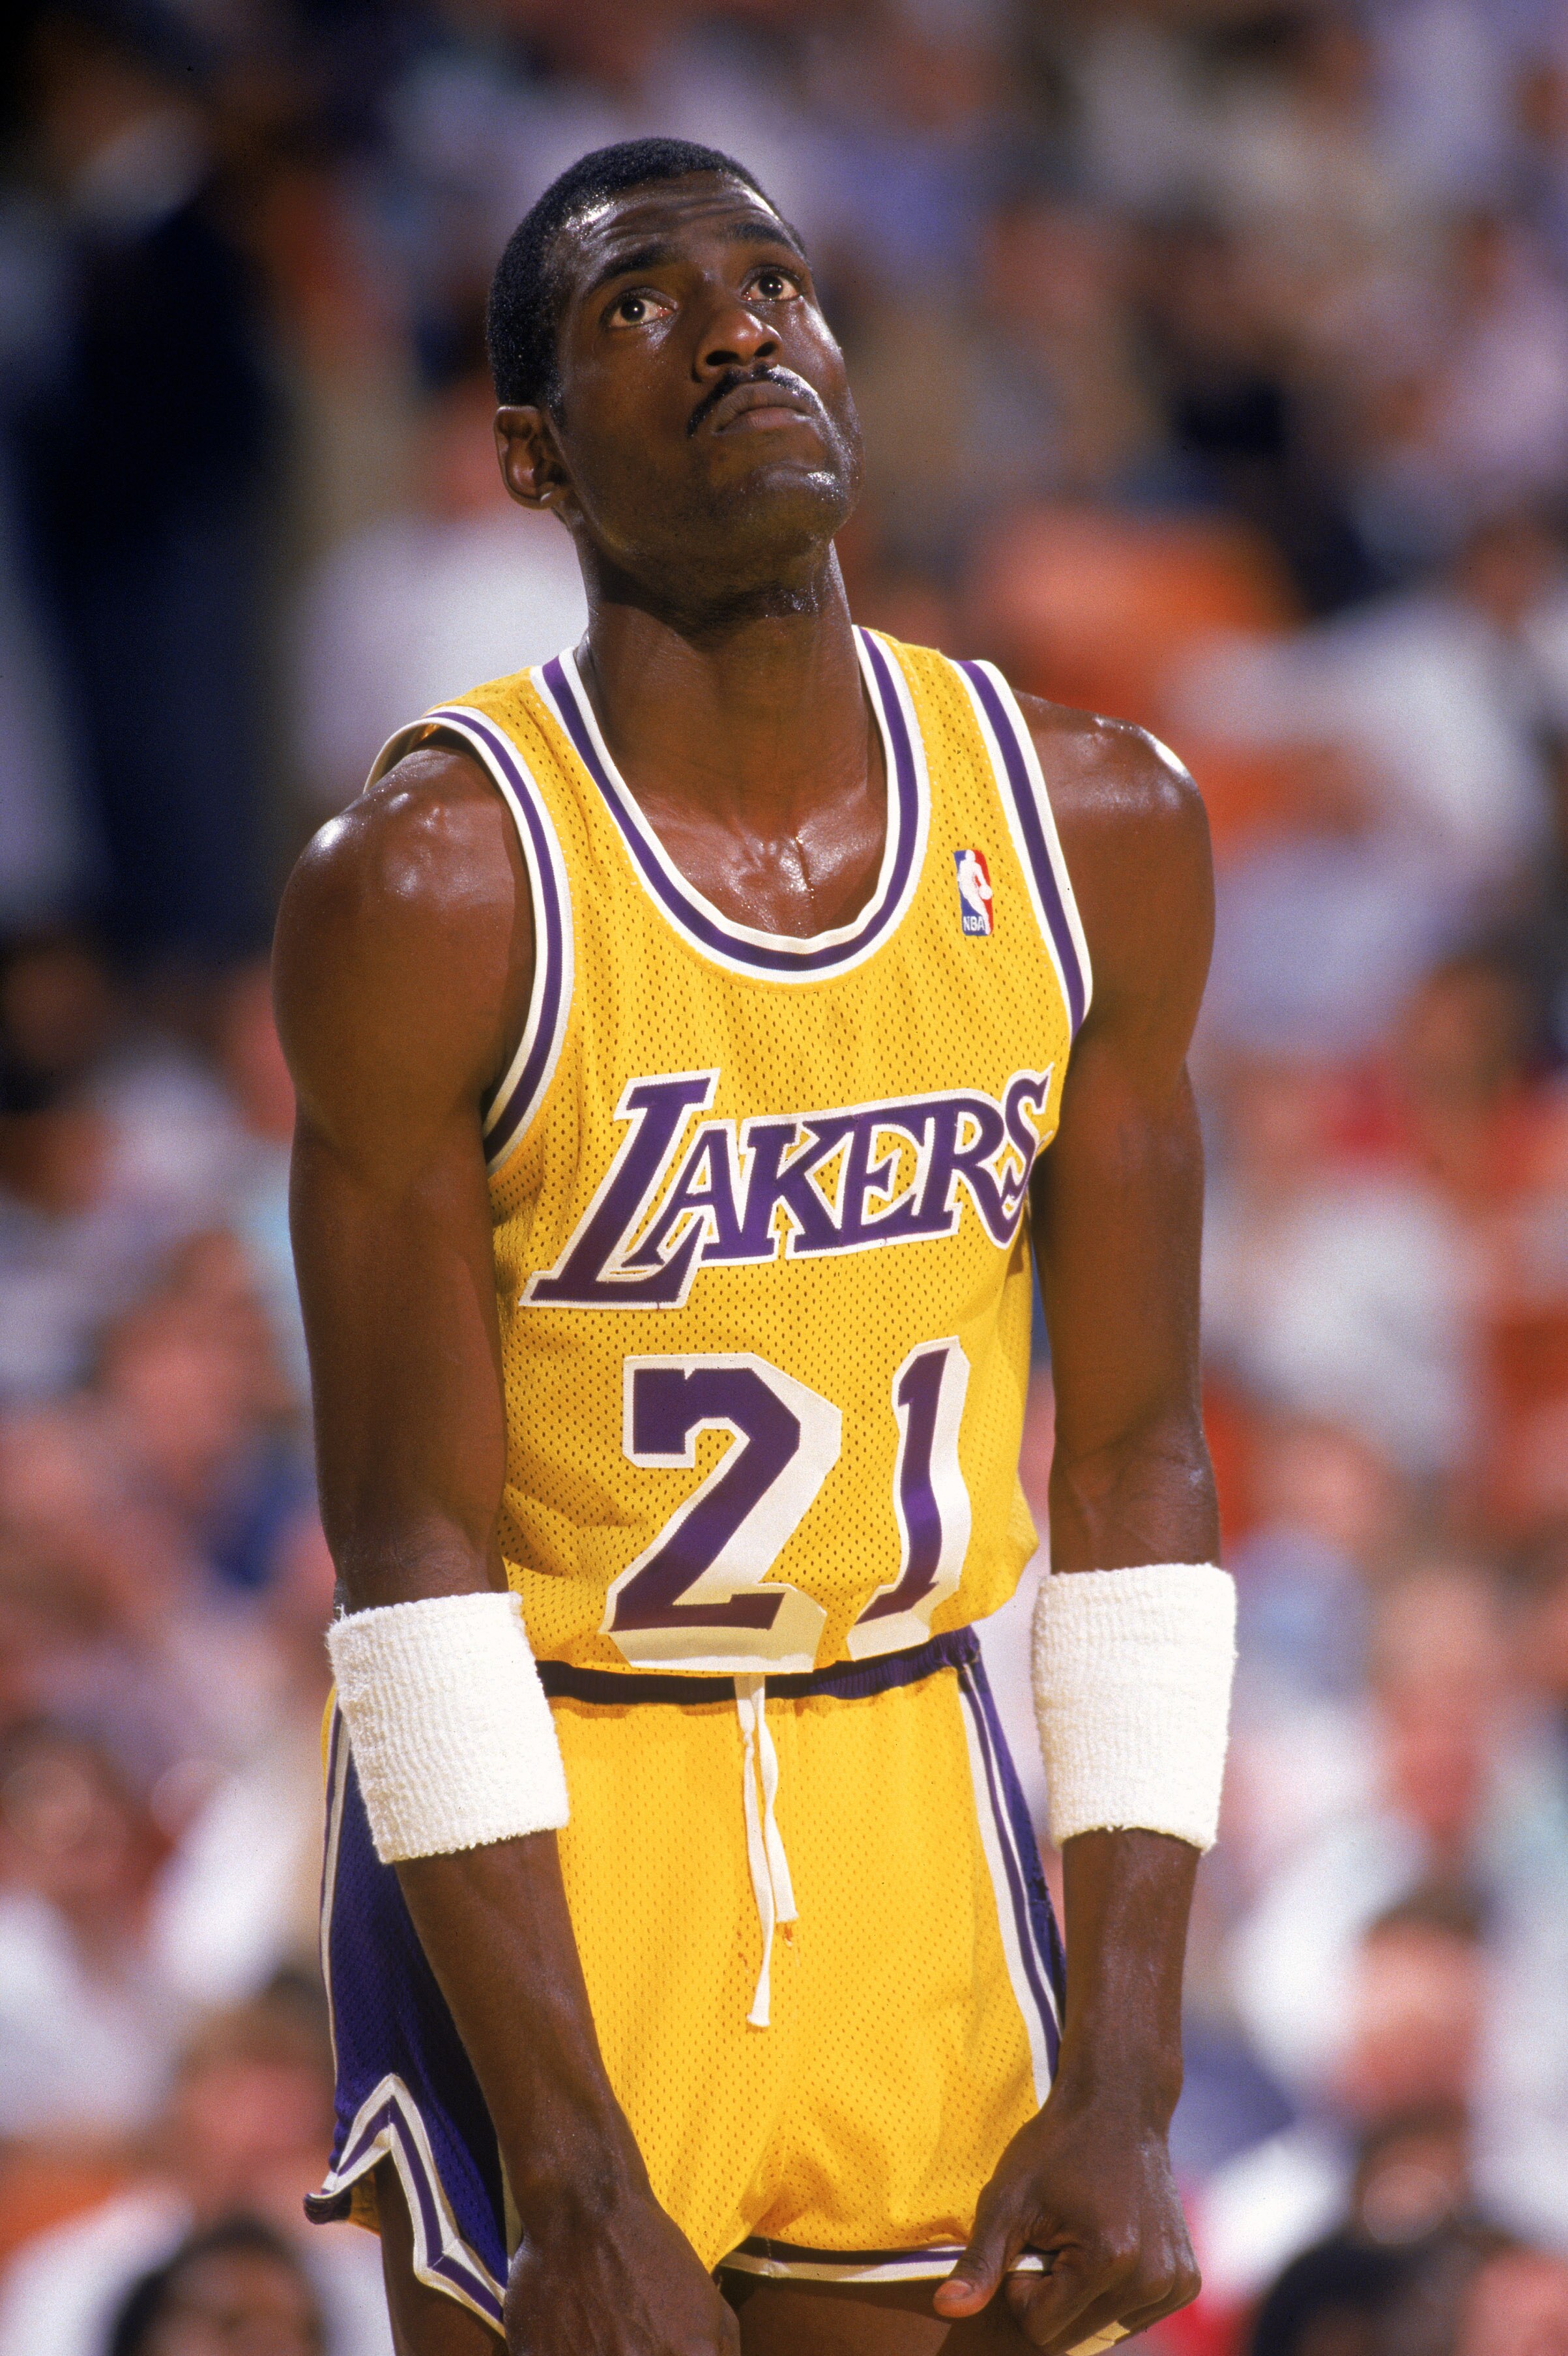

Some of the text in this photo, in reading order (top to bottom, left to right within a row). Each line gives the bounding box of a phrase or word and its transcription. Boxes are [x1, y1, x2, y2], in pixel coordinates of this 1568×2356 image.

[963, 916, 985, 931] NBA
[519, 1064, 1053, 1309] LAKERS
[598, 1336, 971, 1672] 21
